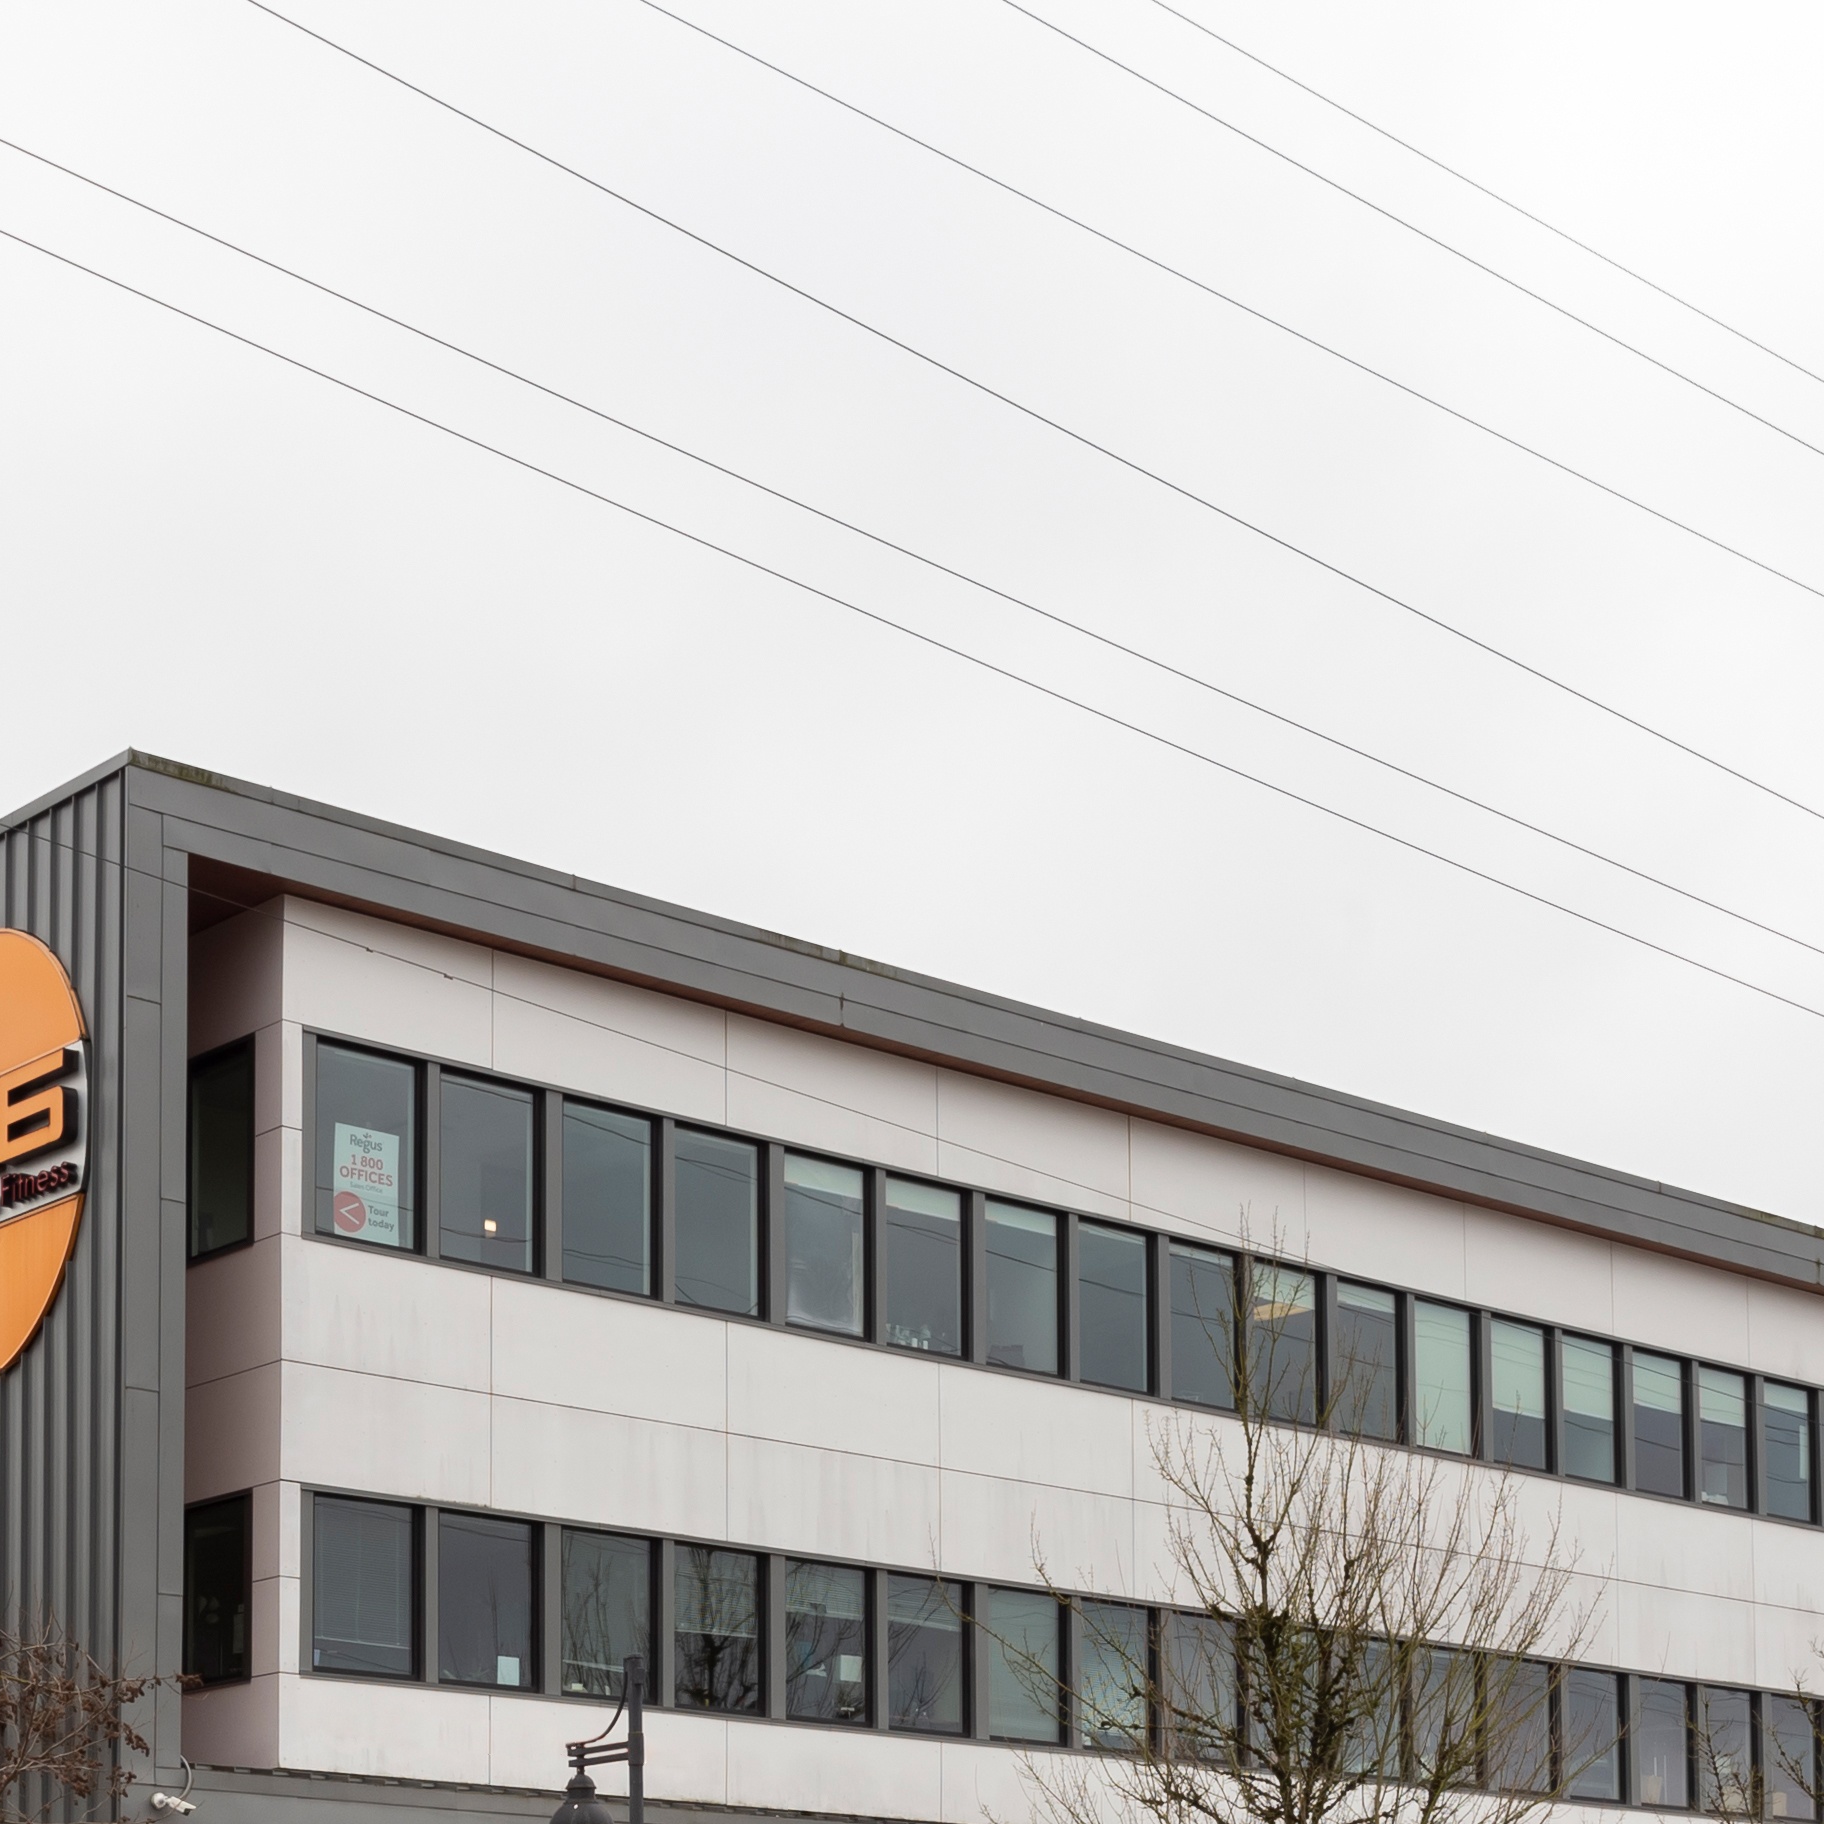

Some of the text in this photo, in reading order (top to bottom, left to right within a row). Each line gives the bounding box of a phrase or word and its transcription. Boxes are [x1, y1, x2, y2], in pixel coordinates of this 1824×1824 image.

[349, 1133, 383, 1154] Regus
[351, 1154, 383, 1171] 1 800
[0, 1161, 74, 1207] Fitness
[339, 1165, 393, 1187] OFFICES
[368, 1205, 389, 1217] Tour
[368, 1218, 395, 1232] today
